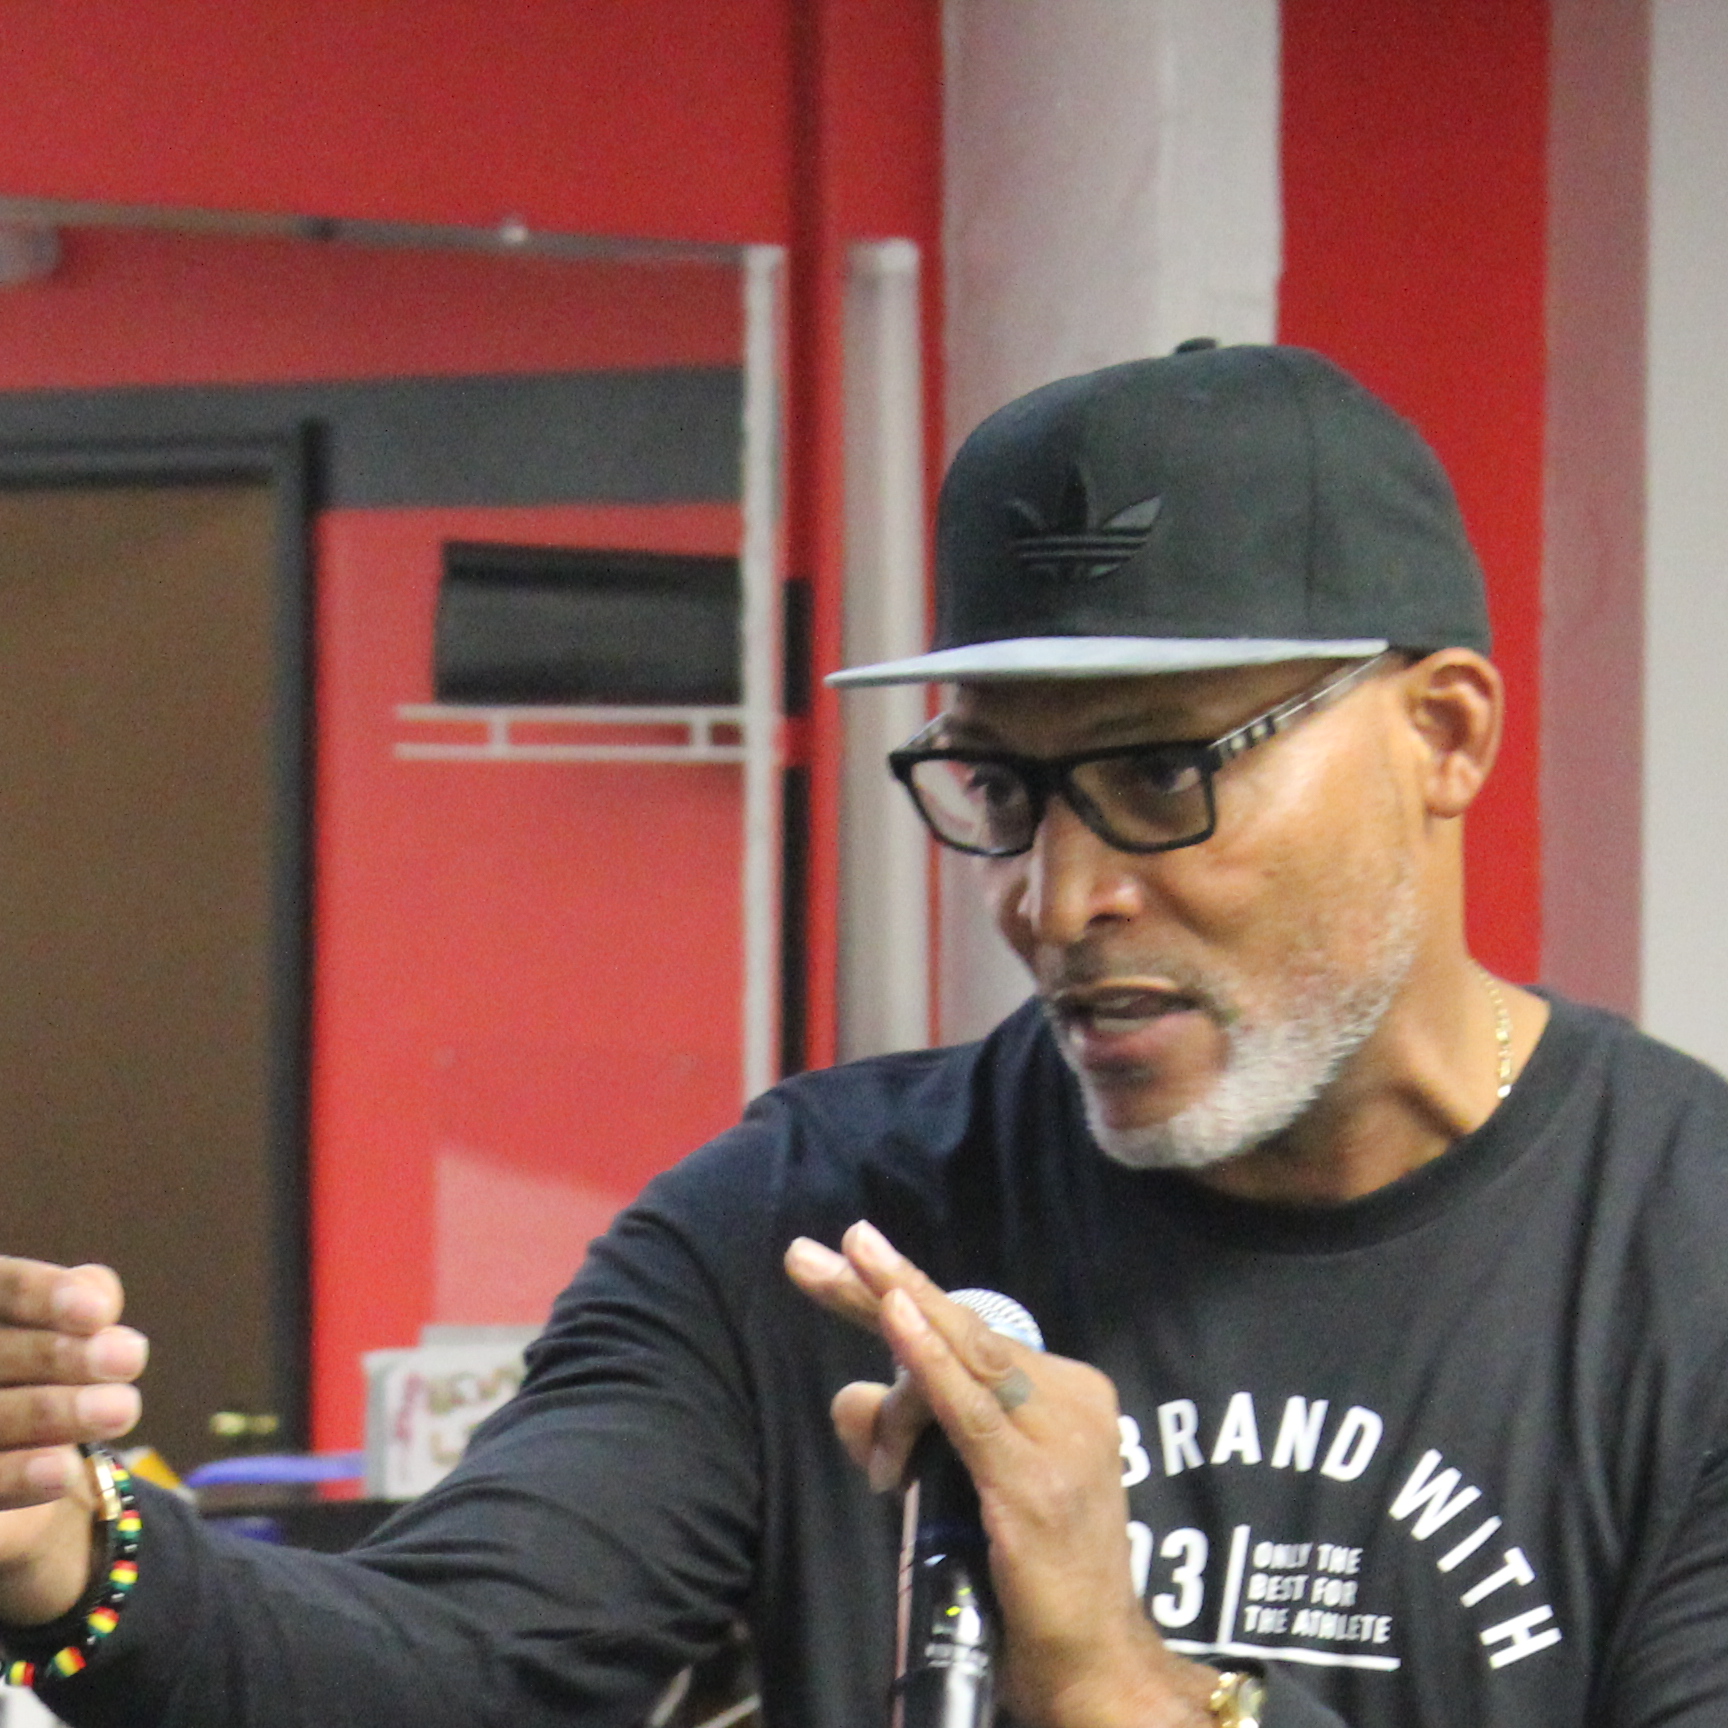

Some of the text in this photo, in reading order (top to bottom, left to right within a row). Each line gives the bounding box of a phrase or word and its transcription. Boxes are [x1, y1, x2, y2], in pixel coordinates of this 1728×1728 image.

[1252, 1540, 1364, 1576] ONLY THE
[1388, 1447, 1563, 1670] WITH
[1247, 1572, 1359, 1609] BEST FOR
[1243, 1604, 1394, 1645] THE ATHLETE
